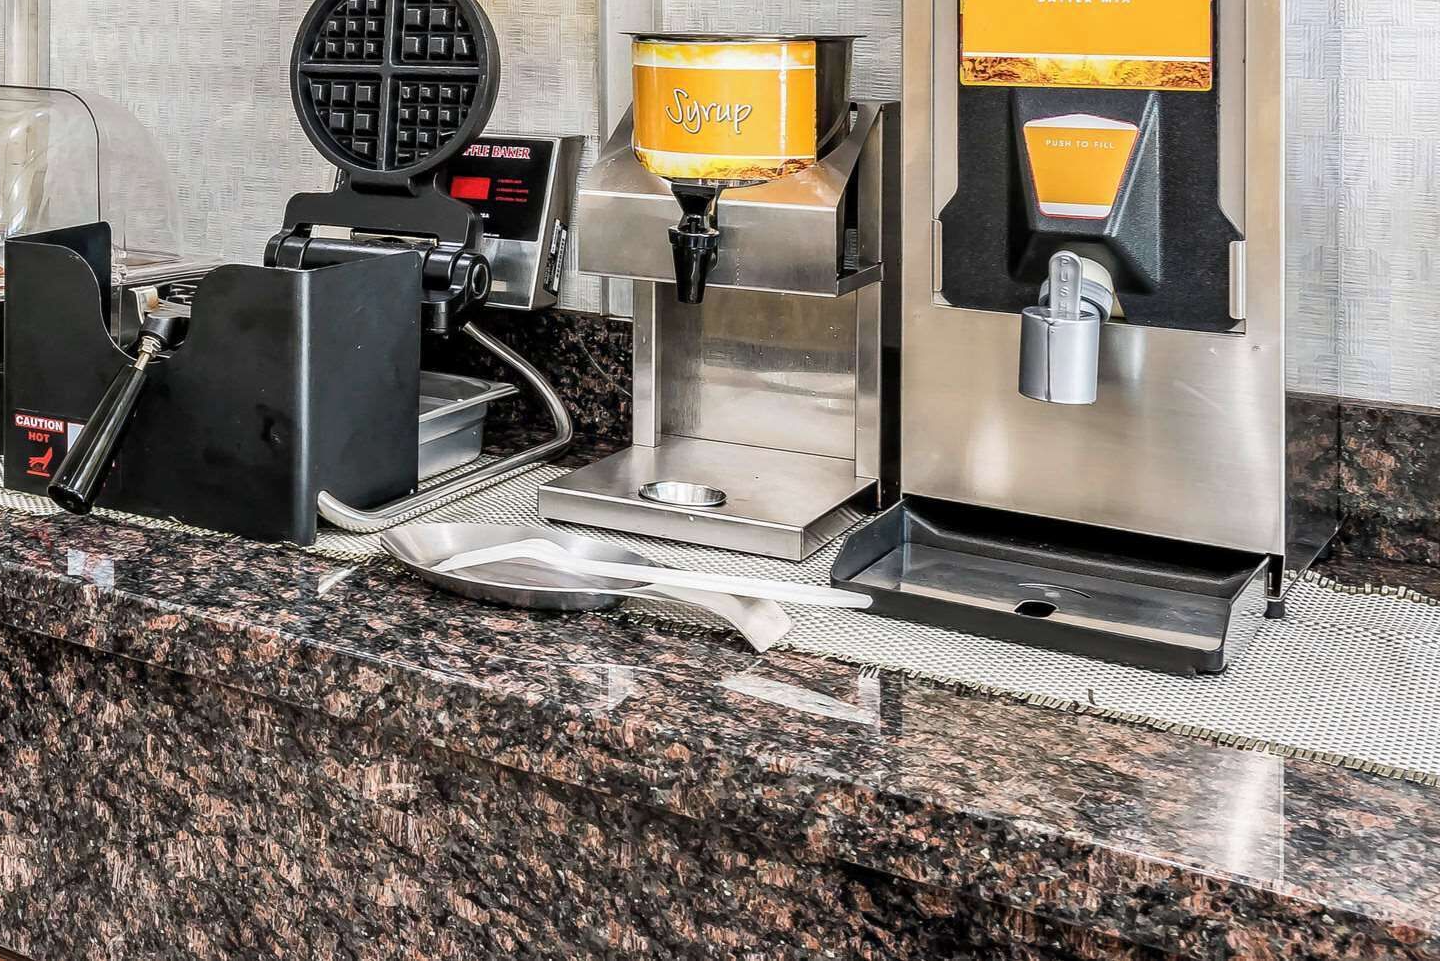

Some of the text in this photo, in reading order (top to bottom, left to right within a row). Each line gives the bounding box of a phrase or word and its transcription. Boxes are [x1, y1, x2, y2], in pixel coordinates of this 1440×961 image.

[665, 87, 752, 135] Syrup
[463, 144, 530, 160] FFLE BAKER
[1046, 138, 1116, 150] PUSH TO FILL
[15, 415, 64, 432] CAUTION
[28, 431, 50, 444] HOT
